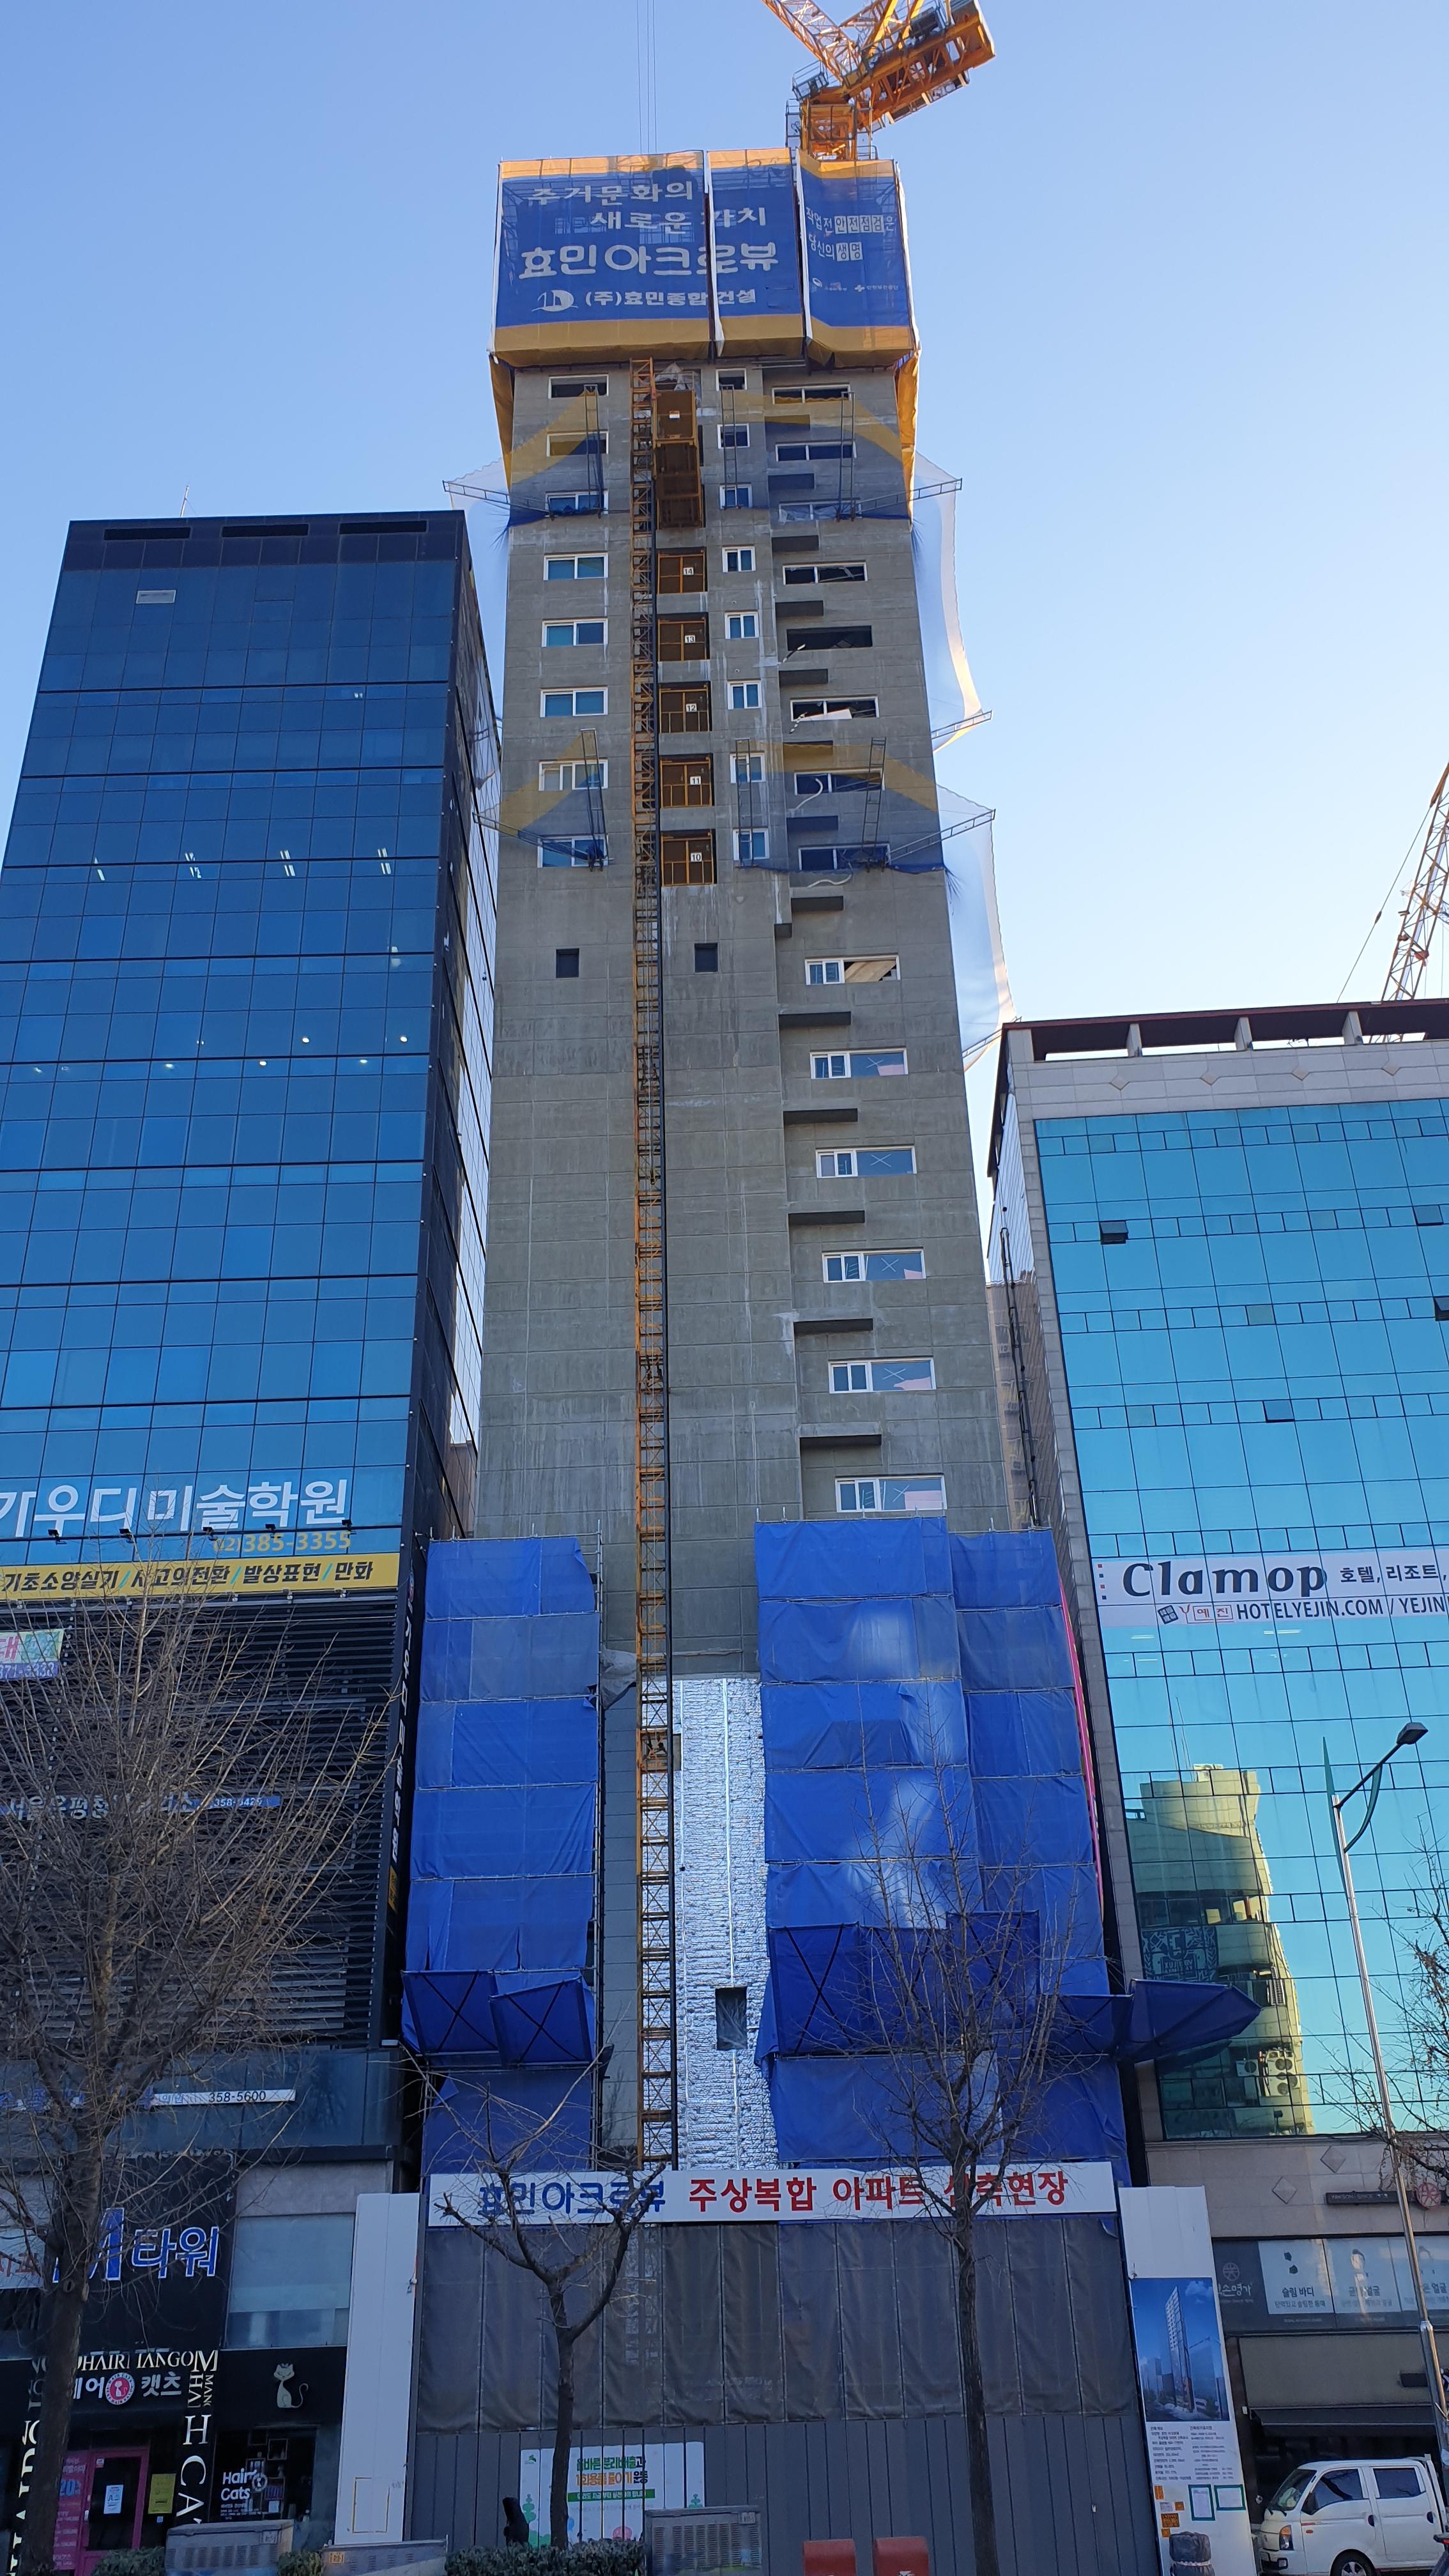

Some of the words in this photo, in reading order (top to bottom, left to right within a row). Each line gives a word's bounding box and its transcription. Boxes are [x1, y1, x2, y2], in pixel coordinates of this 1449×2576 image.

[529, 181, 693, 205] 주거문화의
[591, 211, 692, 234] 새로운
[700, 207, 766, 228] 가치
[809, 233, 834, 260] 당신의
[836, 242, 862, 261] 생명
[518, 243, 778, 280] 효민아크로뷰
[585, 289, 756, 307] (주)효민종합건설
[334, 1561, 374, 1581] 만화
[1123, 1561, 1327, 1597] Clamop
[1237, 1598, 1383, 1620] HOTELYEJIN.COM
[1399, 1596, 1449, 1614] YEJIN
[208, 2090, 266, 2103] 358-5600
[689, 2175, 815, 2213] 주상복합
[833, 2174, 925, 2212] 아파트
[1299, 2286, 1314, 2297] 바디
[141, 2372, 182, 2396] 캣츠
[222, 2468, 257, 2485] Hair
[221, 2487, 250, 2501] Cats
